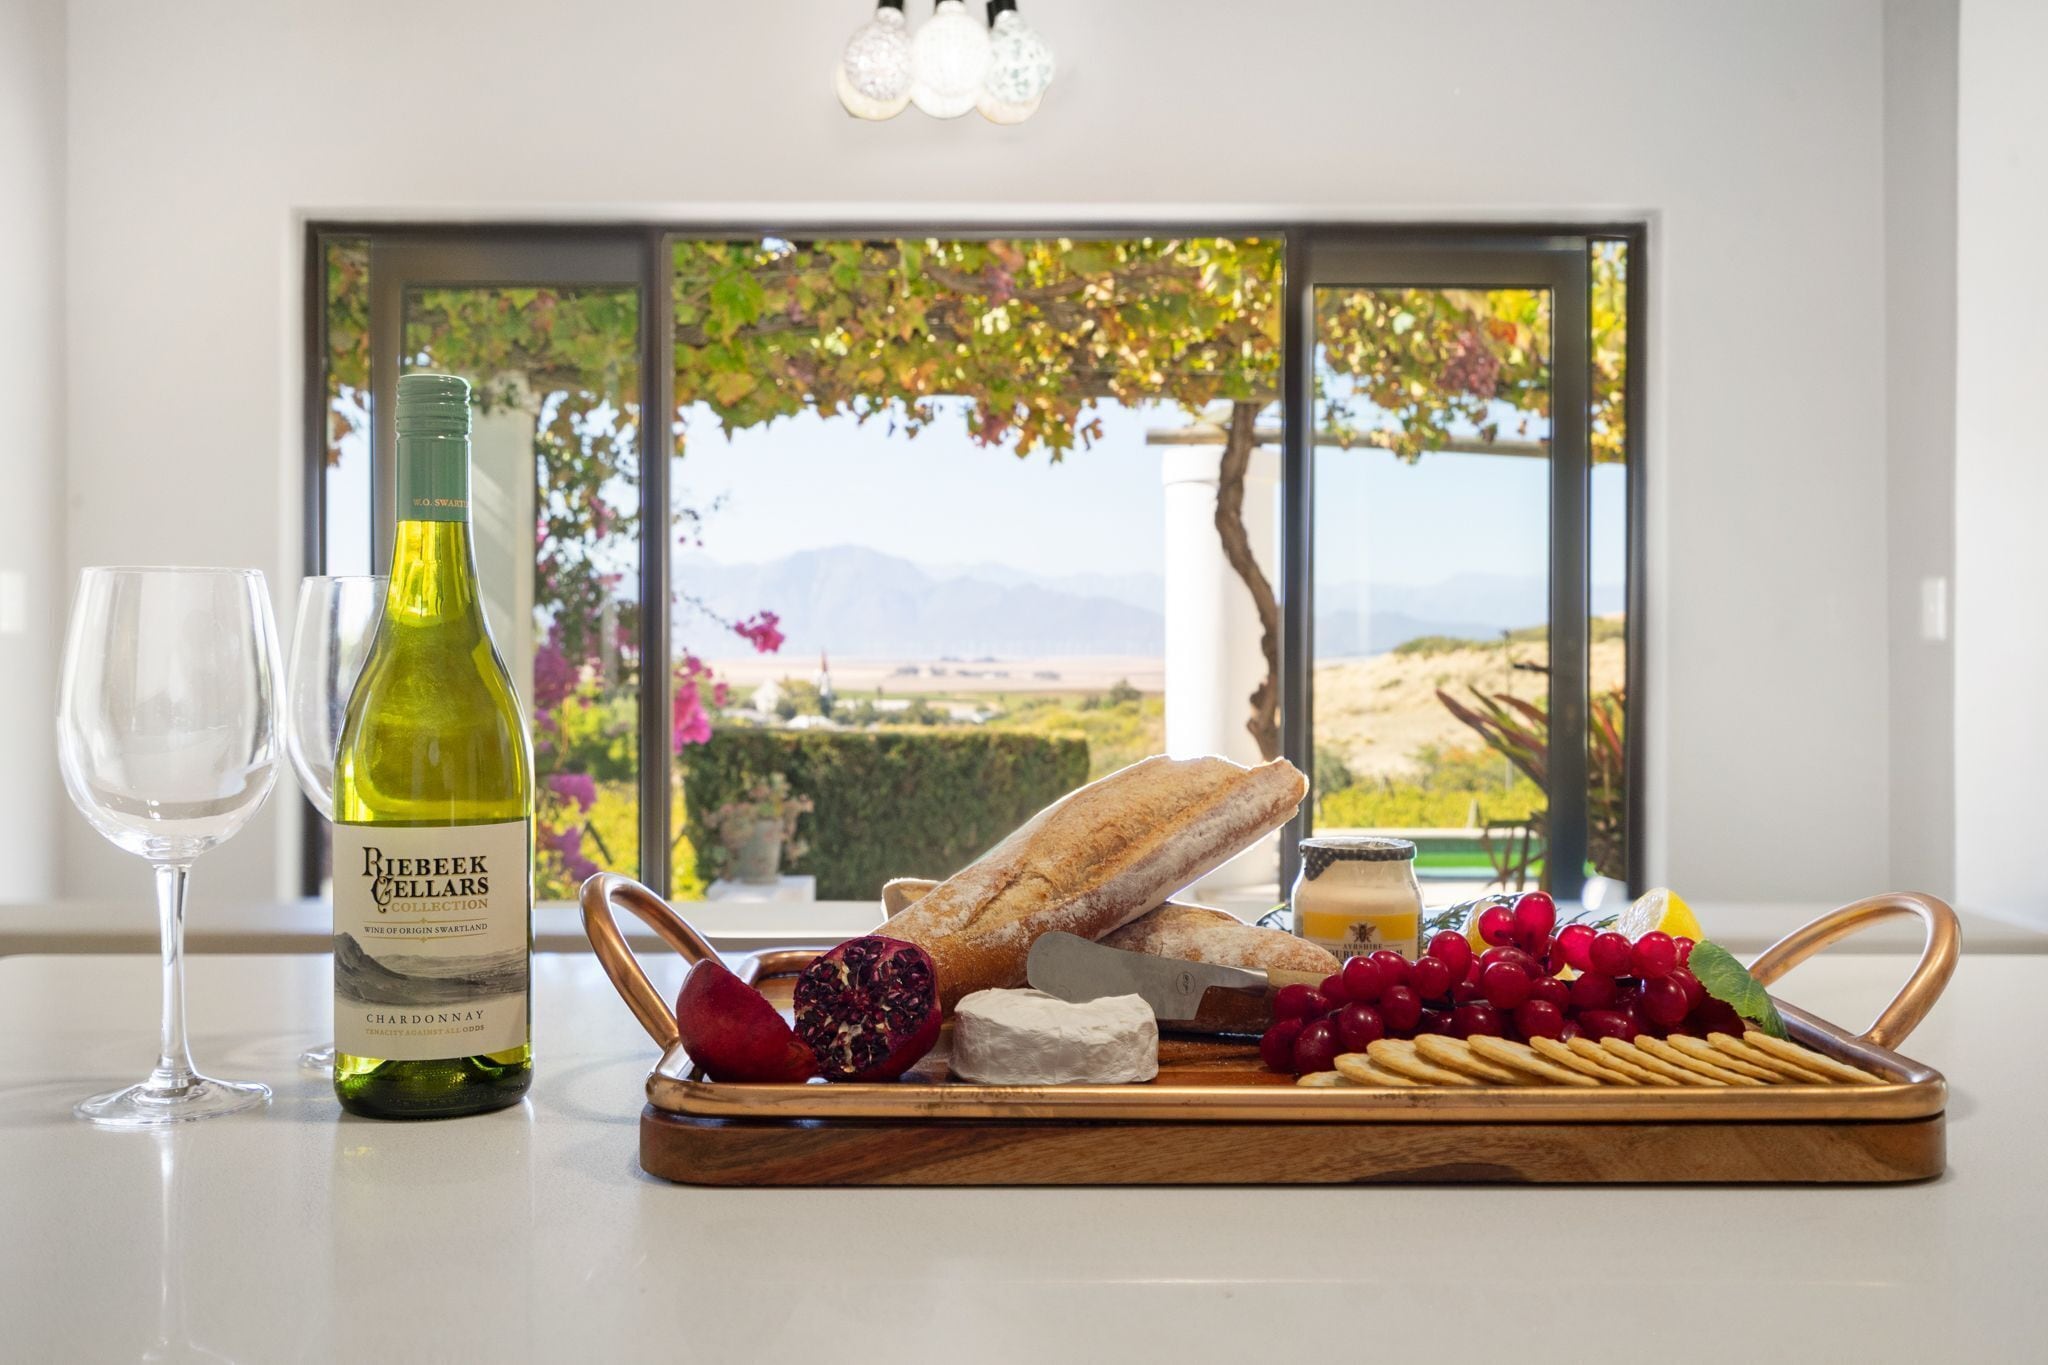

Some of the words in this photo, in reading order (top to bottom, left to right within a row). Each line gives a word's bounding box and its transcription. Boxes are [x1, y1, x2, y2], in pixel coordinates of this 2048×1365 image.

[362, 846, 488, 879] RIEBEEK
[370, 876, 489, 914] CELLARS
[391, 899, 488, 912] COLLECTION
[364, 926, 385, 934] WINE
[399, 927, 433, 935] ORIGIN
[434, 923, 488, 934] SWARTLAND
[366, 1010, 484, 1024] CHARDONNAY
[405, 1028, 443, 1036] AGAINST
[445, 1027, 461, 1035] ALL
[462, 1024, 485, 1033] ODDS
